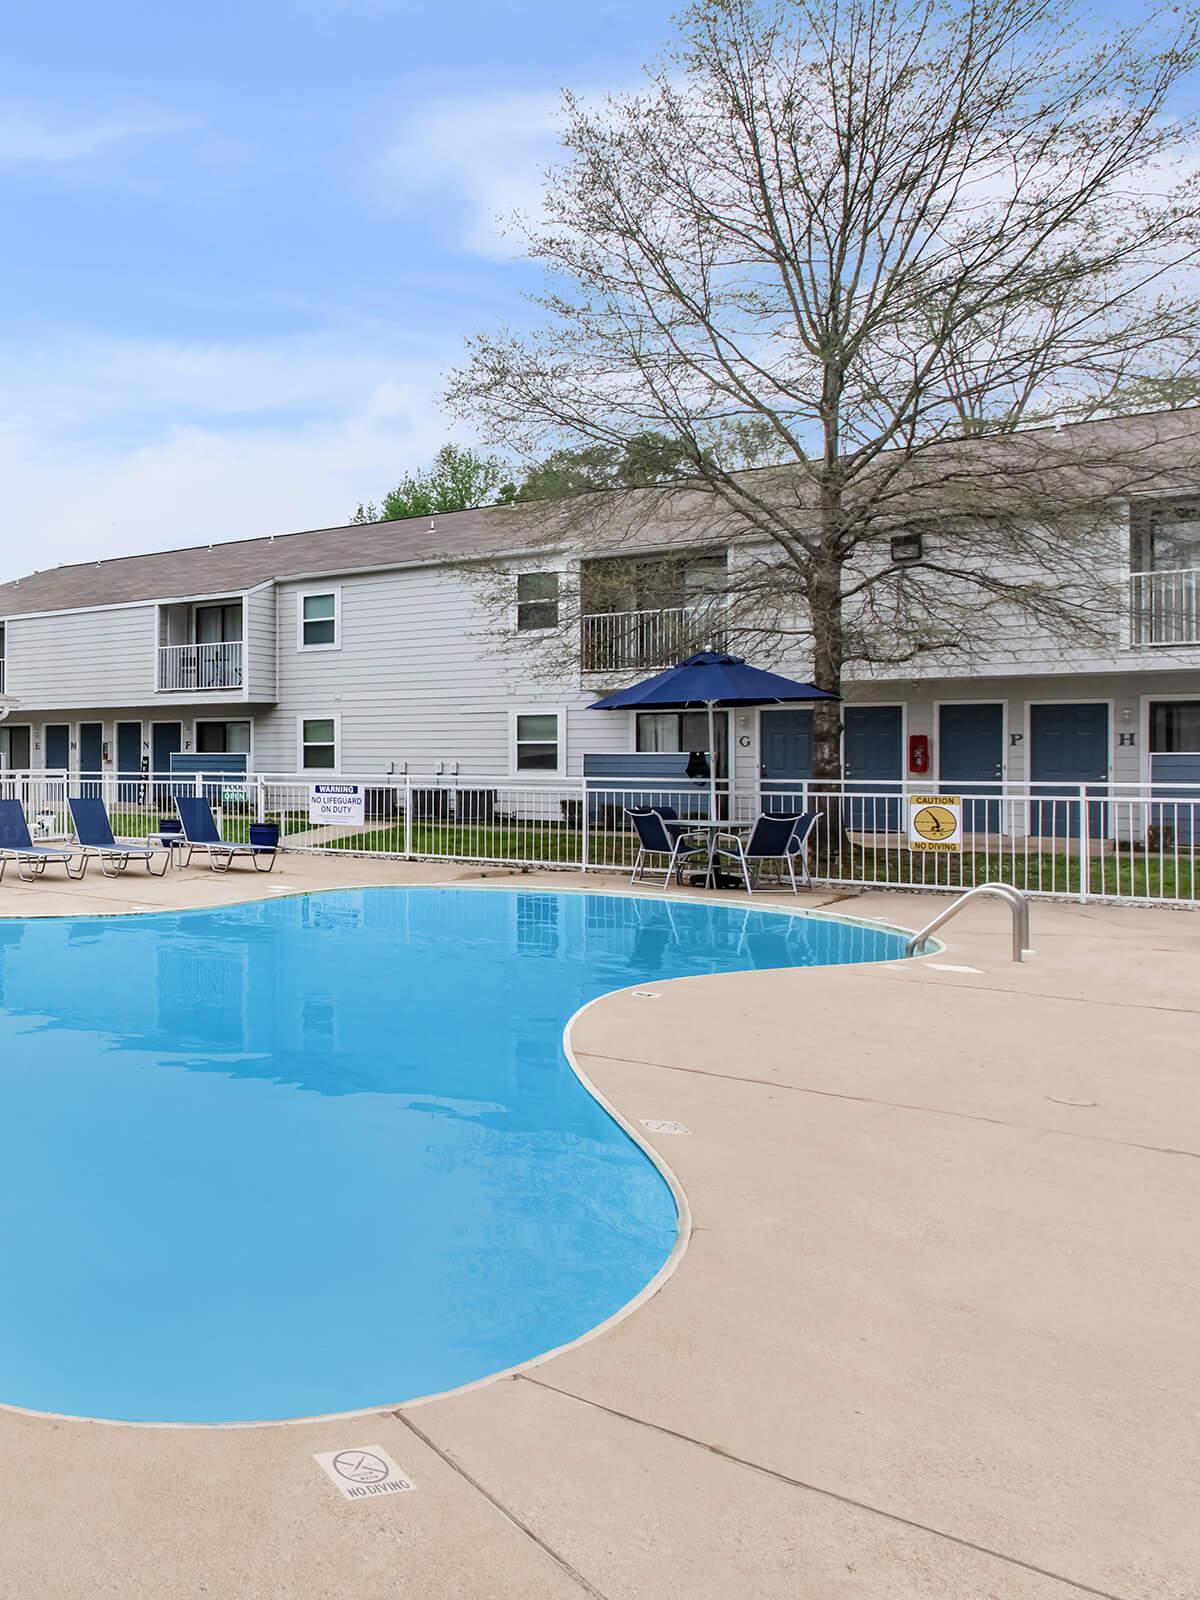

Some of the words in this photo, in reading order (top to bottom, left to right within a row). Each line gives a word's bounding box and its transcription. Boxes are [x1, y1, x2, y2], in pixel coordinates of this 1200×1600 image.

[739, 735, 751, 747] G
[1010, 734, 1024, 746] P
[1119, 733, 1136, 746] H
[319, 785, 354, 794] WARNING
[311, 796, 322, 804] NO
[323, 797, 362, 805] LIFEGUARD
[916, 797, 954, 805] CAUTION
[333, 806, 352, 814] DUTY
[928, 842, 957, 850] DIVING
[346, 1487, 367, 1497] NO
[366, 1479, 410, 1494] DIVING
